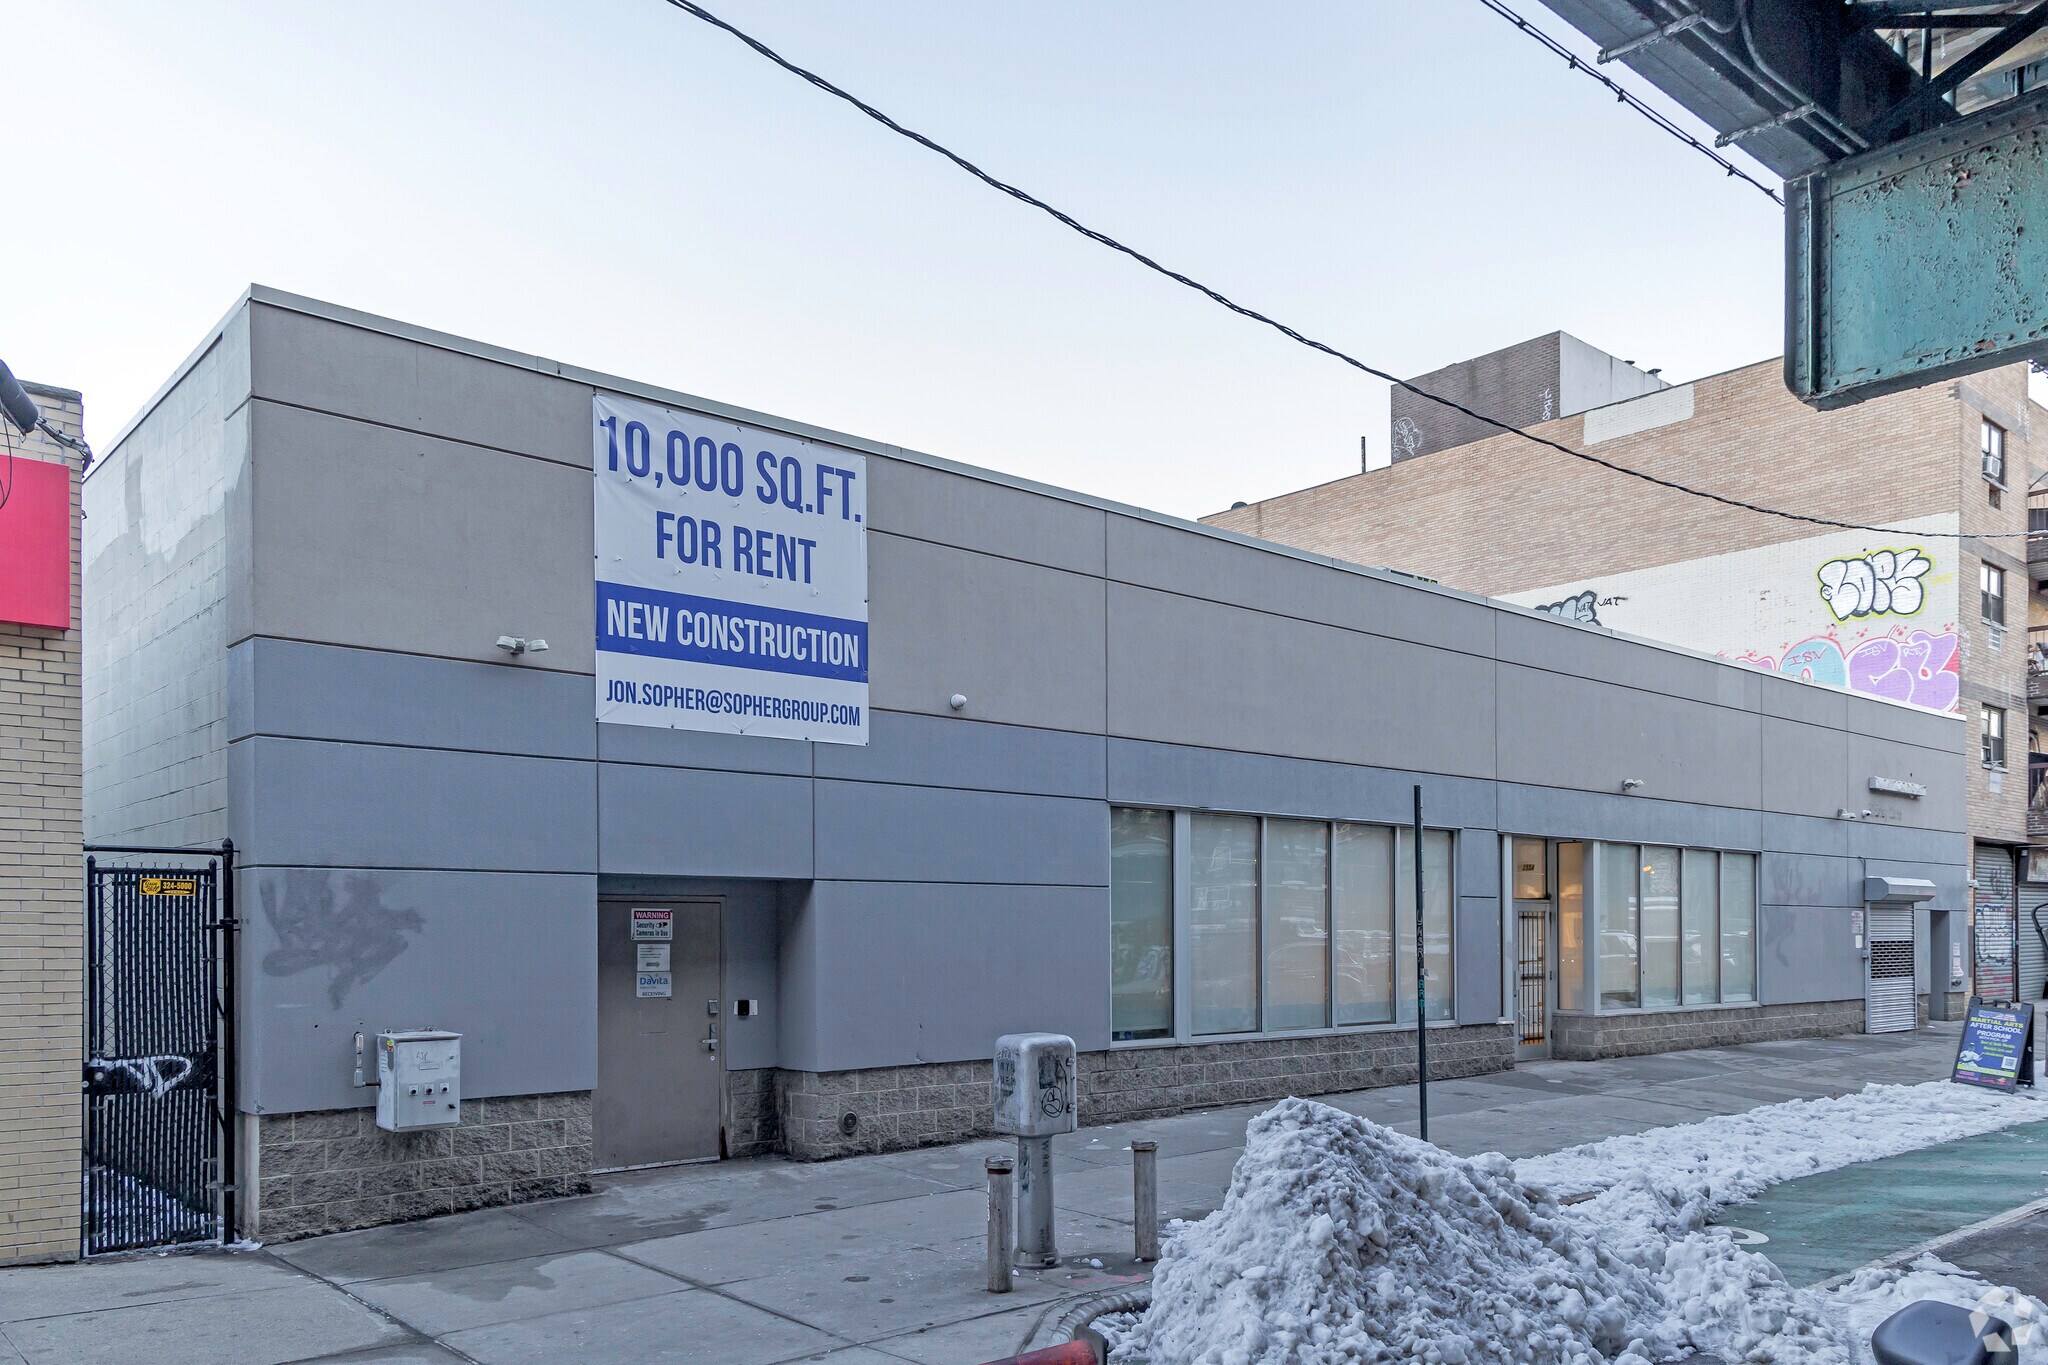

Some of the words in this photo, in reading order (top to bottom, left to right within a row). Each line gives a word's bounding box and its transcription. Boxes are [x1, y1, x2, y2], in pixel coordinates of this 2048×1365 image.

[600, 415, 744, 498] 10,000
[756, 450, 862, 523] SQ.FT.
[656, 510, 722, 569] FOR
[733, 525, 817, 584] RENT
[607, 598, 669, 643] NEW
[677, 609, 859, 668] CONSTRUCTION
[606, 679, 861, 727] JON.SOPHER@SOPHERGROUP.COM
[635, 911, 669, 919] WARNING
[640, 975, 669, 985] DaVita
[1970, 1016, 2002, 1025] MARTIAL
[1970, 1022, 1993, 1030] AFTER
[1993, 1025, 2022, 1034] SCHOOL
[1977, 1030, 2011, 1039] PROGRAM
